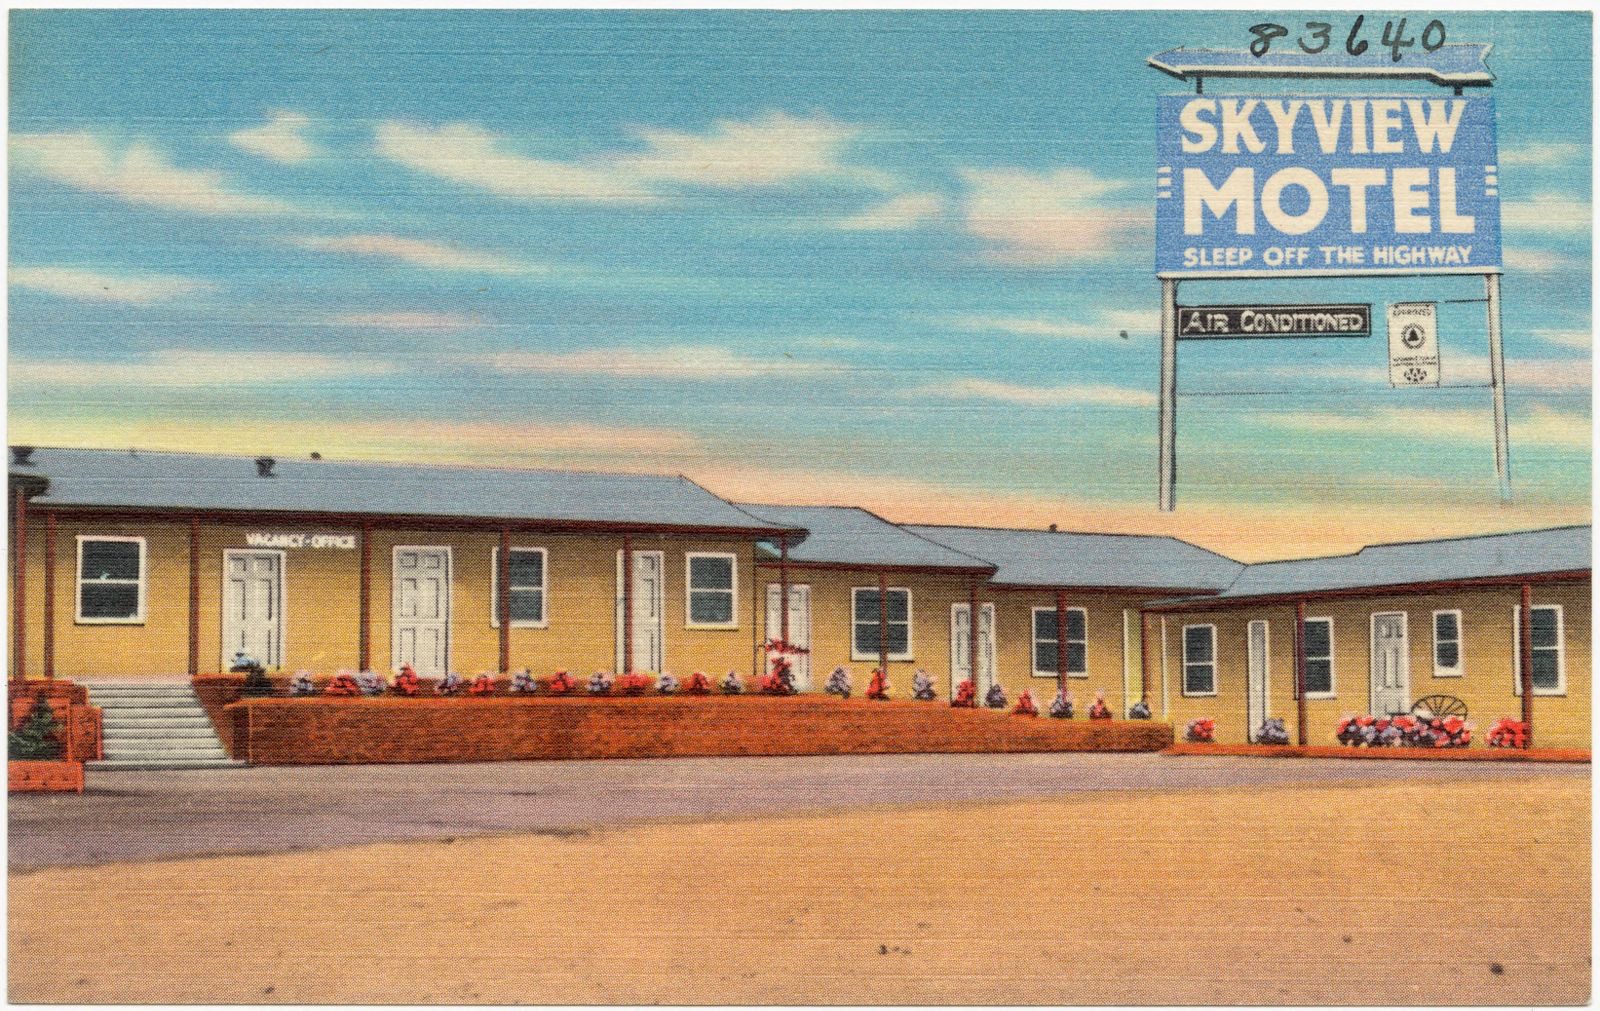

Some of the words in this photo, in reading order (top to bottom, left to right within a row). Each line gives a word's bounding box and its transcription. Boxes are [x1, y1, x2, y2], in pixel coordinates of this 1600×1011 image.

[1249, 15, 1447, 62] 83640
[1179, 98, 1468, 155] SKYVIEW
[1182, 166, 1476, 236] MOTEL
[1183, 247, 1253, 269] SLEEP
[1263, 247, 1310, 267] OFF
[1317, 246, 1365, 266] THE
[1373, 245, 1473, 266] HIGHWAY
[1183, 311, 1230, 333] AIR
[1240, 310, 1364, 332] CONDITIONED
